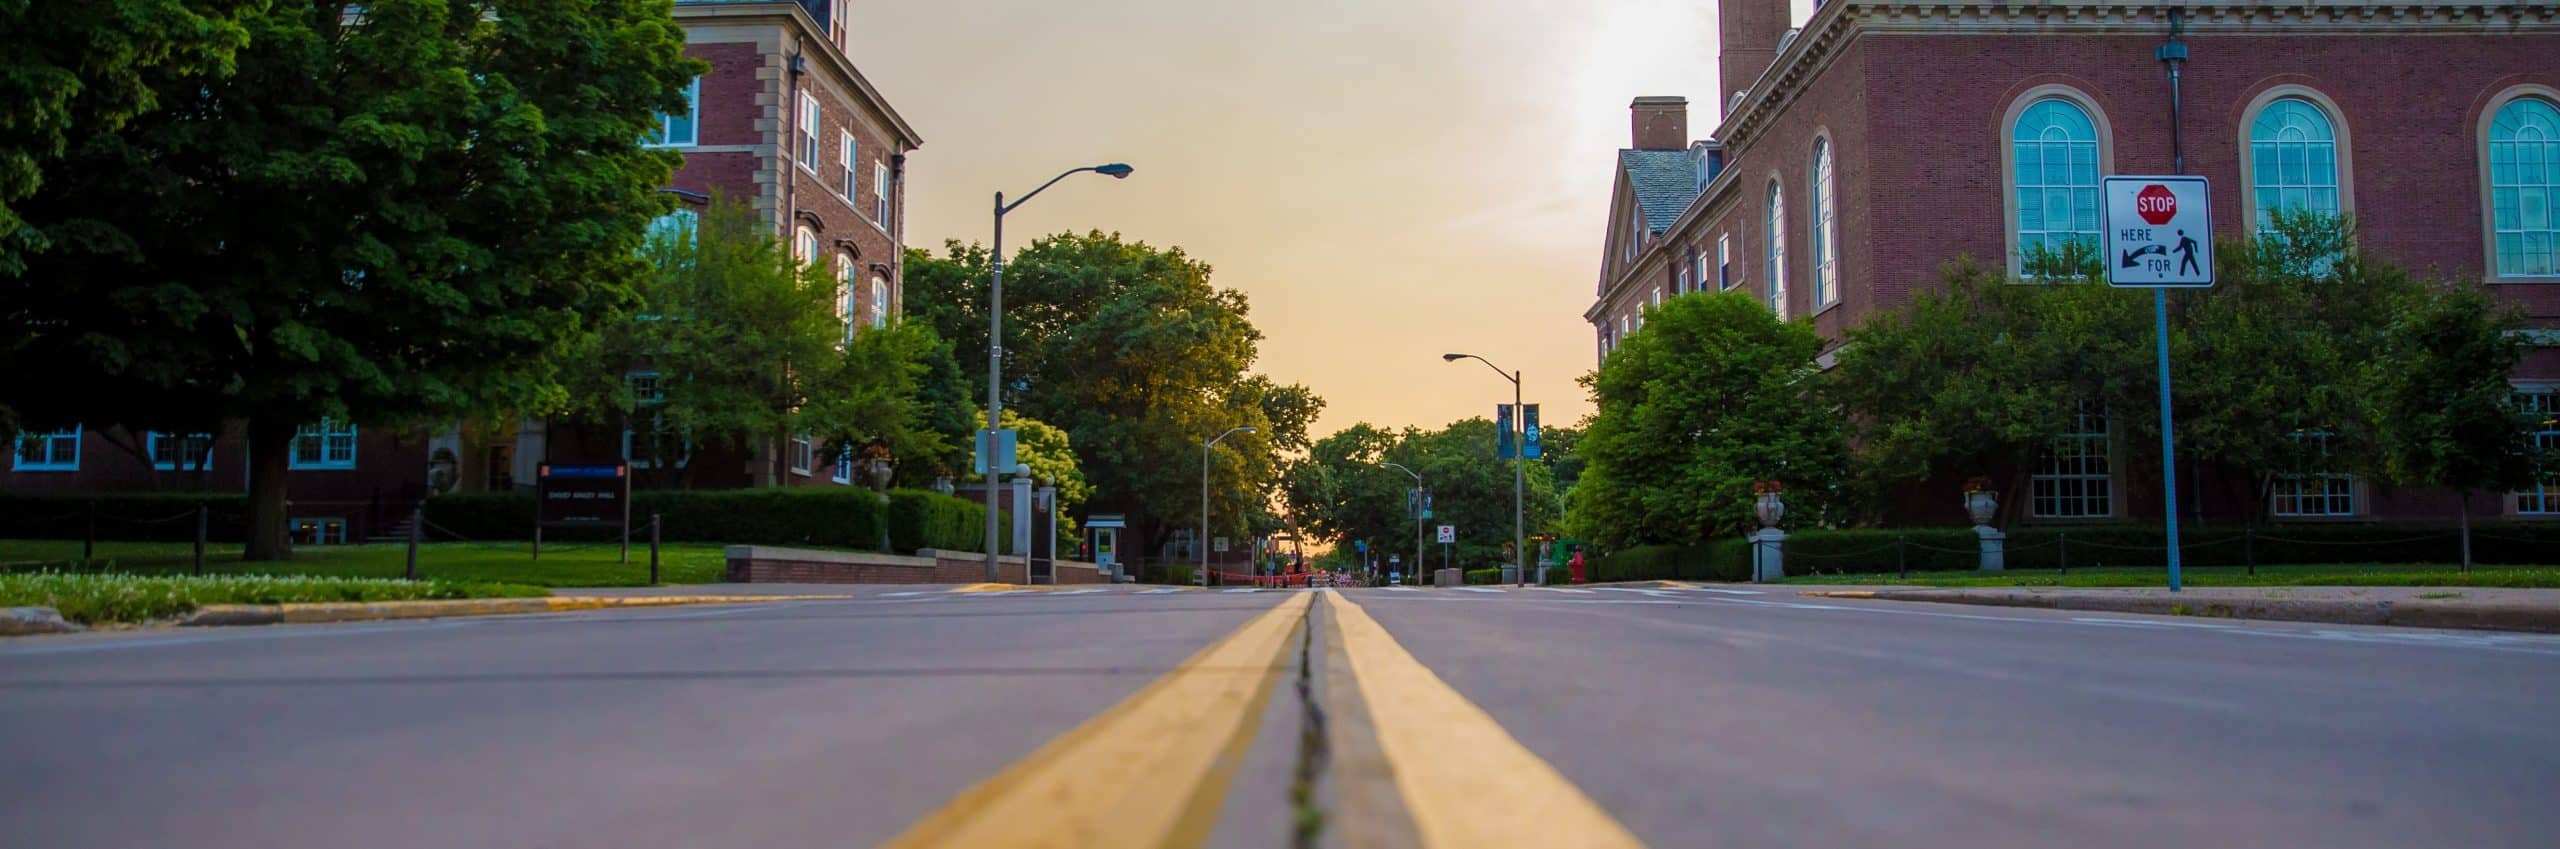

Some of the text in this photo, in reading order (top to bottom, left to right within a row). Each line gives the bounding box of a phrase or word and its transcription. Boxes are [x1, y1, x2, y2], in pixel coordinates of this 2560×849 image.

[2140, 197, 2174, 212] STOP
[2121, 229, 2152, 241] HERE
[2148, 259, 2171, 272] FOR
